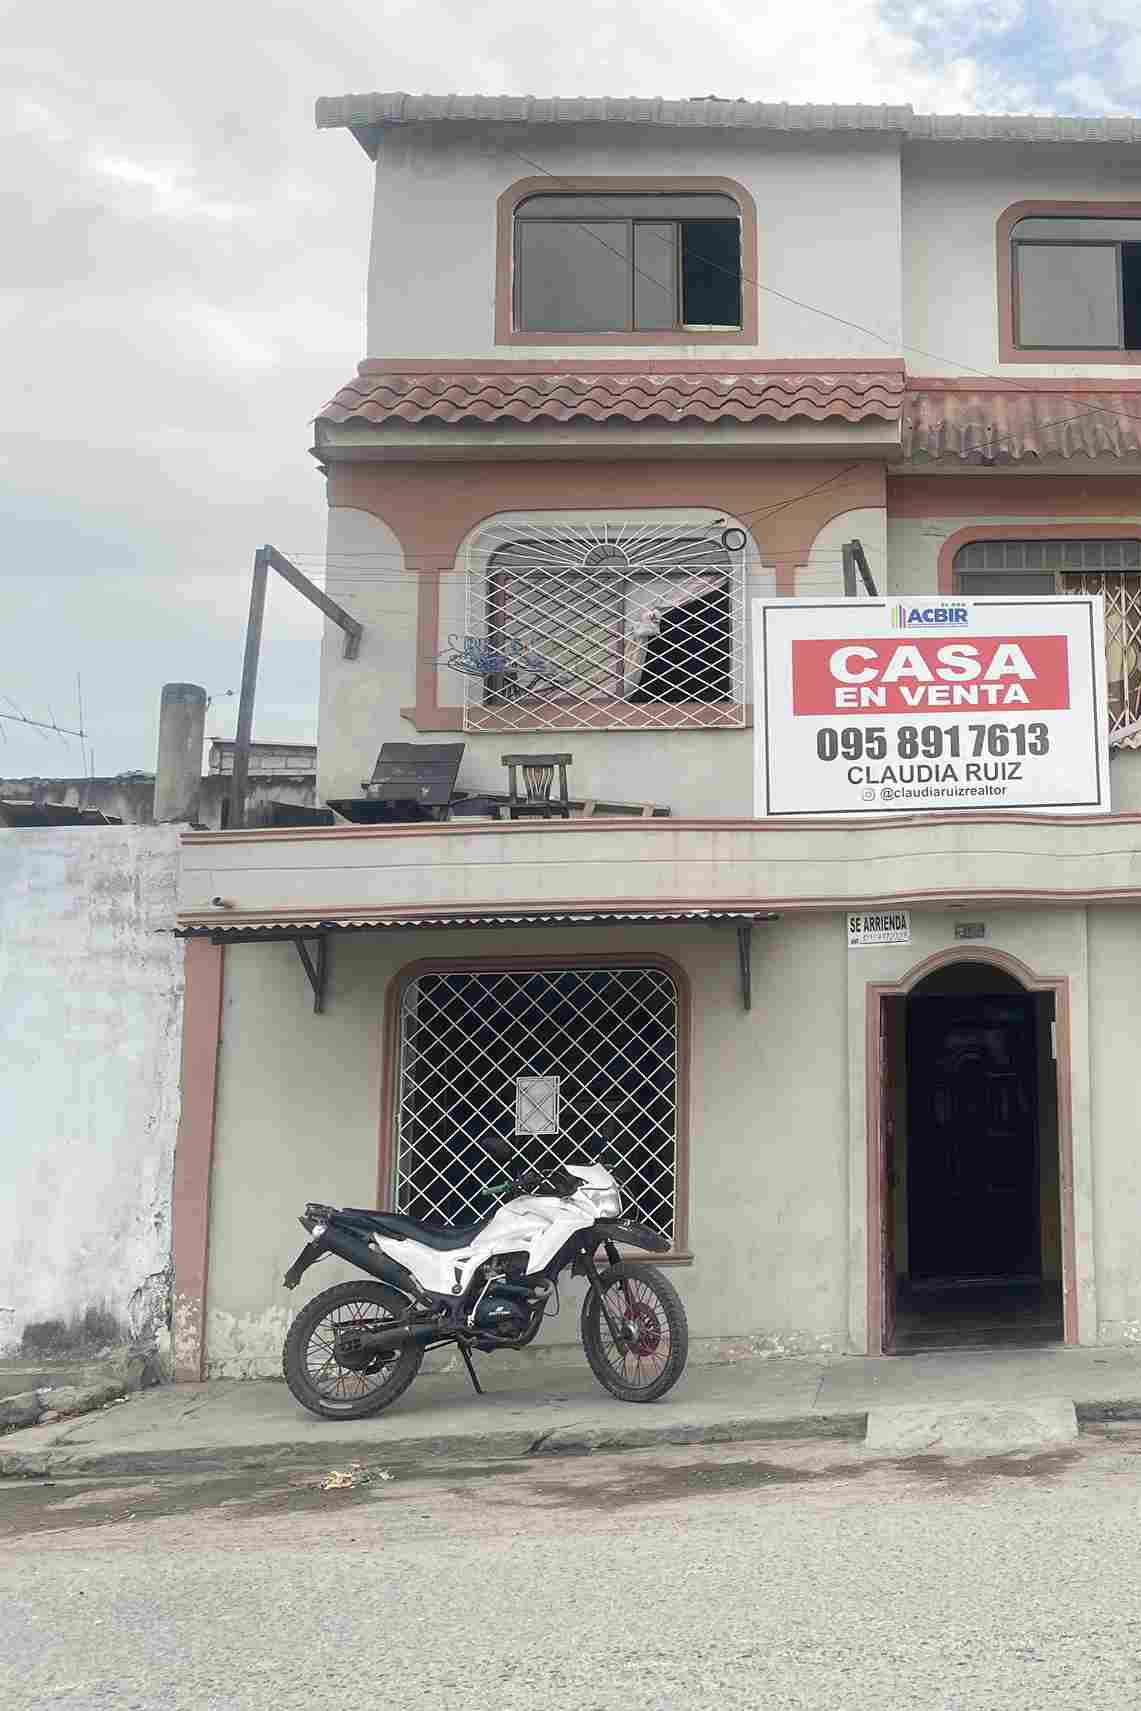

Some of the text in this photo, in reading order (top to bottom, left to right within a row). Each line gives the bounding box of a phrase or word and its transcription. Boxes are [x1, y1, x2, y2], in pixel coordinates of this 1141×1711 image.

[907, 608, 968, 623] ACBIR
[829, 643, 1037, 683] CASA
[834, 684, 1030, 708] EN VENTA
[816, 723, 1049, 762] 095 891 7613
[848, 762, 1022, 785] CLAUDIA RUIZ
[881, 785, 1007, 800] @claudiaruizrealtor
[850, 915, 906, 932] SE ARRIENDA
